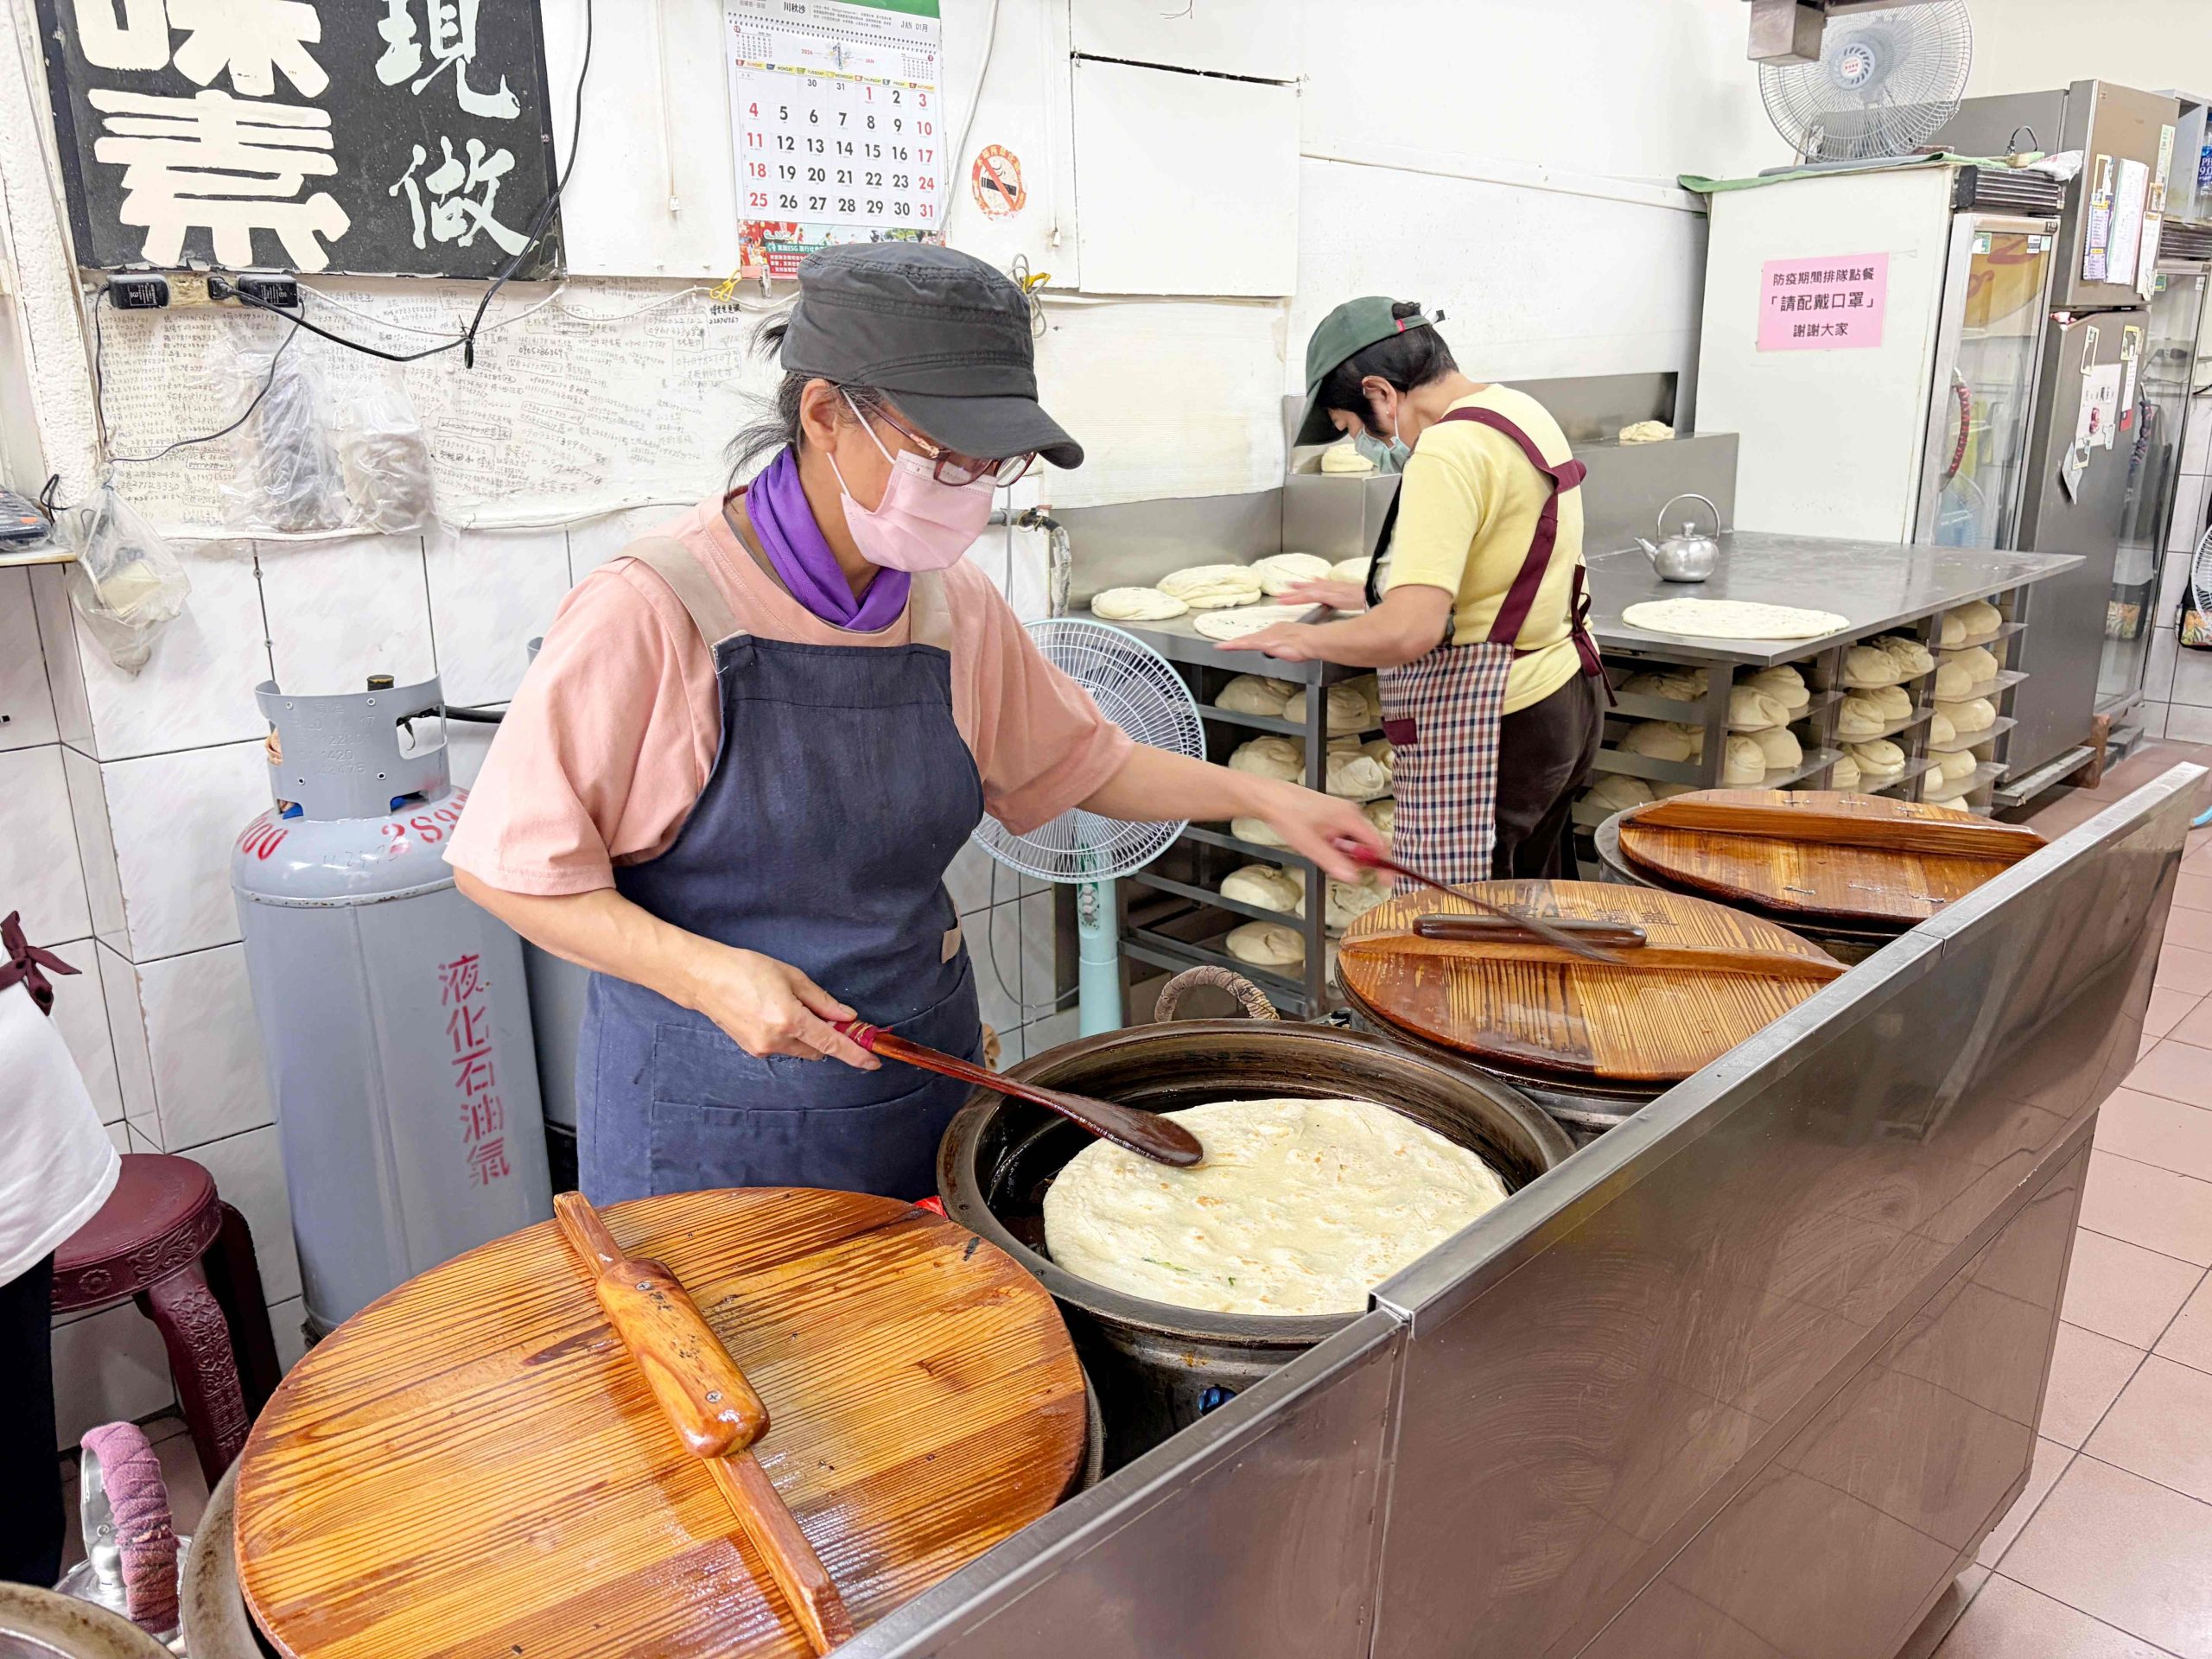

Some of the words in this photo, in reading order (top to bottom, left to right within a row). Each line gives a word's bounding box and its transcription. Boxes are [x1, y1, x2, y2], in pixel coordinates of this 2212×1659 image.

[900, 21, 912, 29] JAN
[807, 79, 817, 87] 30
[836, 82, 845, 91] 31
[866, 86, 872, 100] 1
[893, 90, 900, 105] 2
[918, 93, 927, 107] 3
[749, 102, 759, 118] 4
[779, 105, 788, 121] 5
[809, 109, 818, 124] 6
[838, 111, 848, 126] 7
[867, 115, 875, 130] 8
[893, 118, 902, 132] 9
[917, 121, 932, 136] 10
[747, 132, 763, 148] 11
[777, 135, 795, 151] 12
[807, 137, 824, 154] 13
[836, 141, 854, 156] 14
[865, 143, 881, 158] 15
[892, 146, 908, 161] 16
[918, 149, 933, 163] 17
[749, 162, 766, 178] 18
[779, 164, 797, 180] 19
[807, 167, 826, 182] 20
[836, 169, 853, 184] 21
[865, 171, 882, 187] 22
[893, 174, 909, 188] 23
[918, 176, 935, 190] 24
[749, 192, 768, 207] 25
[779, 194, 798, 209] 26
[809, 196, 827, 211] 27
[838, 198, 856, 213] 28
[867, 200, 884, 214] 29
[893, 201, 911, 216] 30
[920, 203, 933, 218] 31
[1773, 267, 1874, 286] 防疫期間排隊點餐
[1771, 291, 1873, 312] 「請配戴口罩」
[1793, 322, 1848, 337] 謝謝大家
[438, 954, 510, 1185] 液化石油氣
